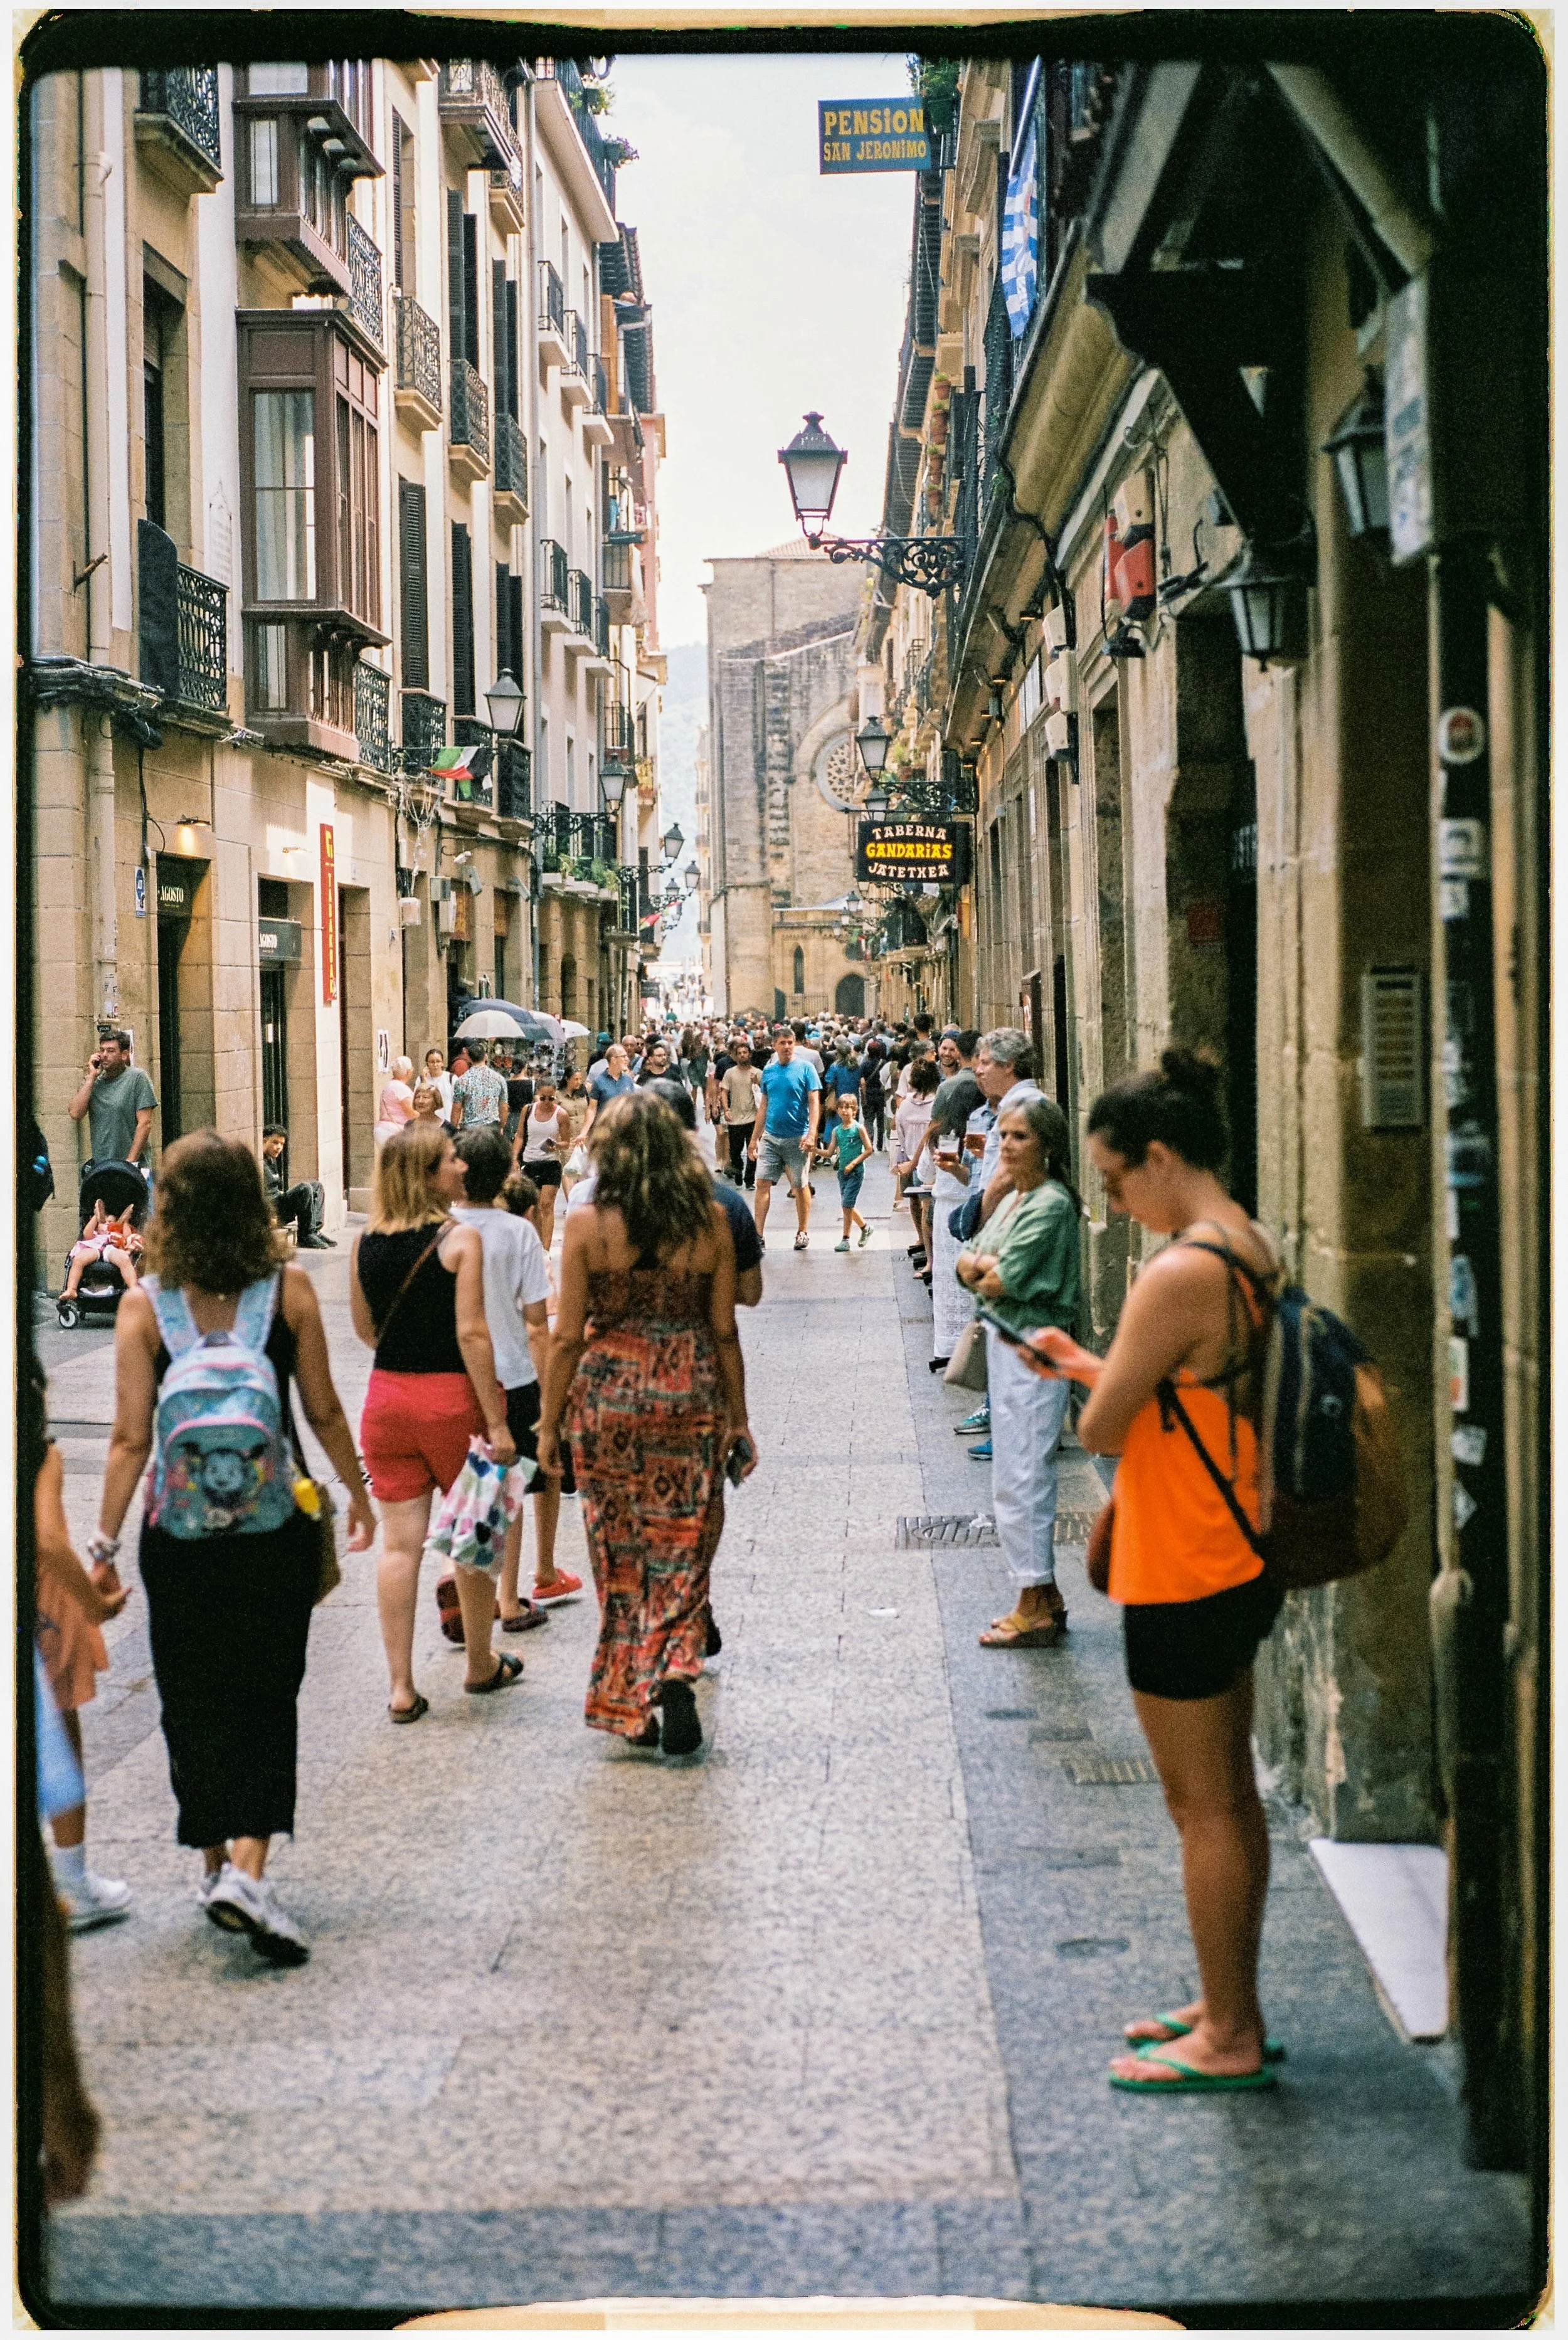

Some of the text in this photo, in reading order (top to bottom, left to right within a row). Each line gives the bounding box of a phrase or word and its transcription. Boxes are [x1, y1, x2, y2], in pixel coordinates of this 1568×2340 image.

[824, 142, 851, 161] SAN
[872, 825, 946, 840] TABERNA
[869, 862, 950, 878] JATETXEA
[160, 885, 184, 903] AGOSTO
